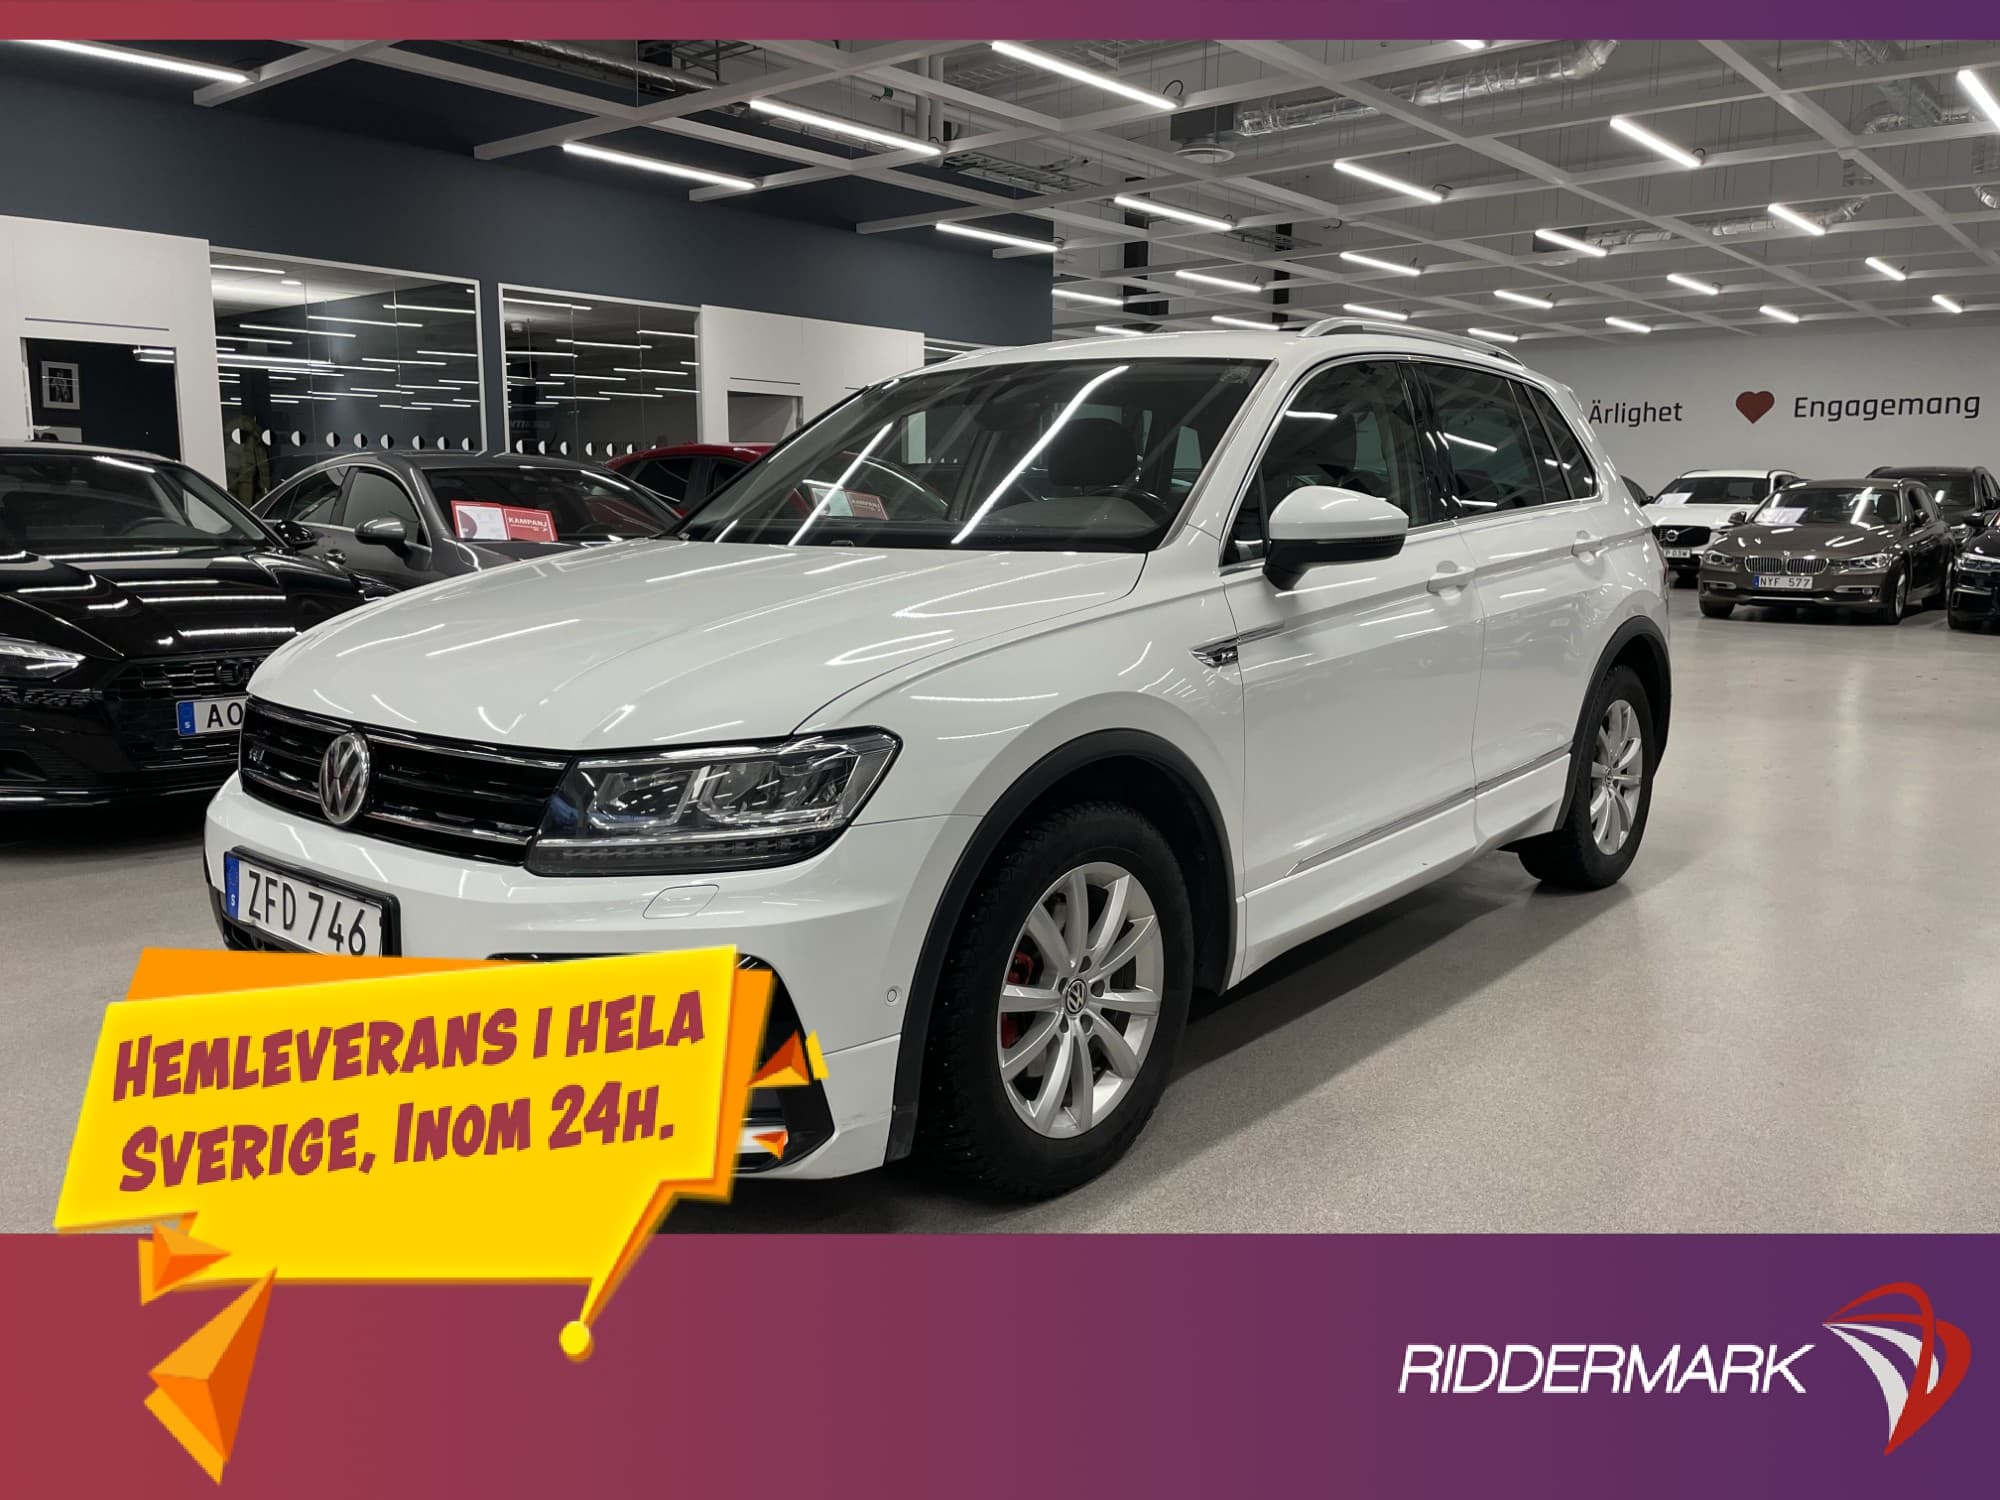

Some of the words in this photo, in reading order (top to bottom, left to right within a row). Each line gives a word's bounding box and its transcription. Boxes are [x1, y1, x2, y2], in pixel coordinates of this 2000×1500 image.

[1588, 401, 1683, 427] Ärlighet
[1794, 396, 1981, 421] Engagemang
[1760, 577, 1780, 587] NYF
[1789, 577, 1811, 587] 577
[248, 870, 297, 931] ZFD
[308, 891, 367, 957] 746
